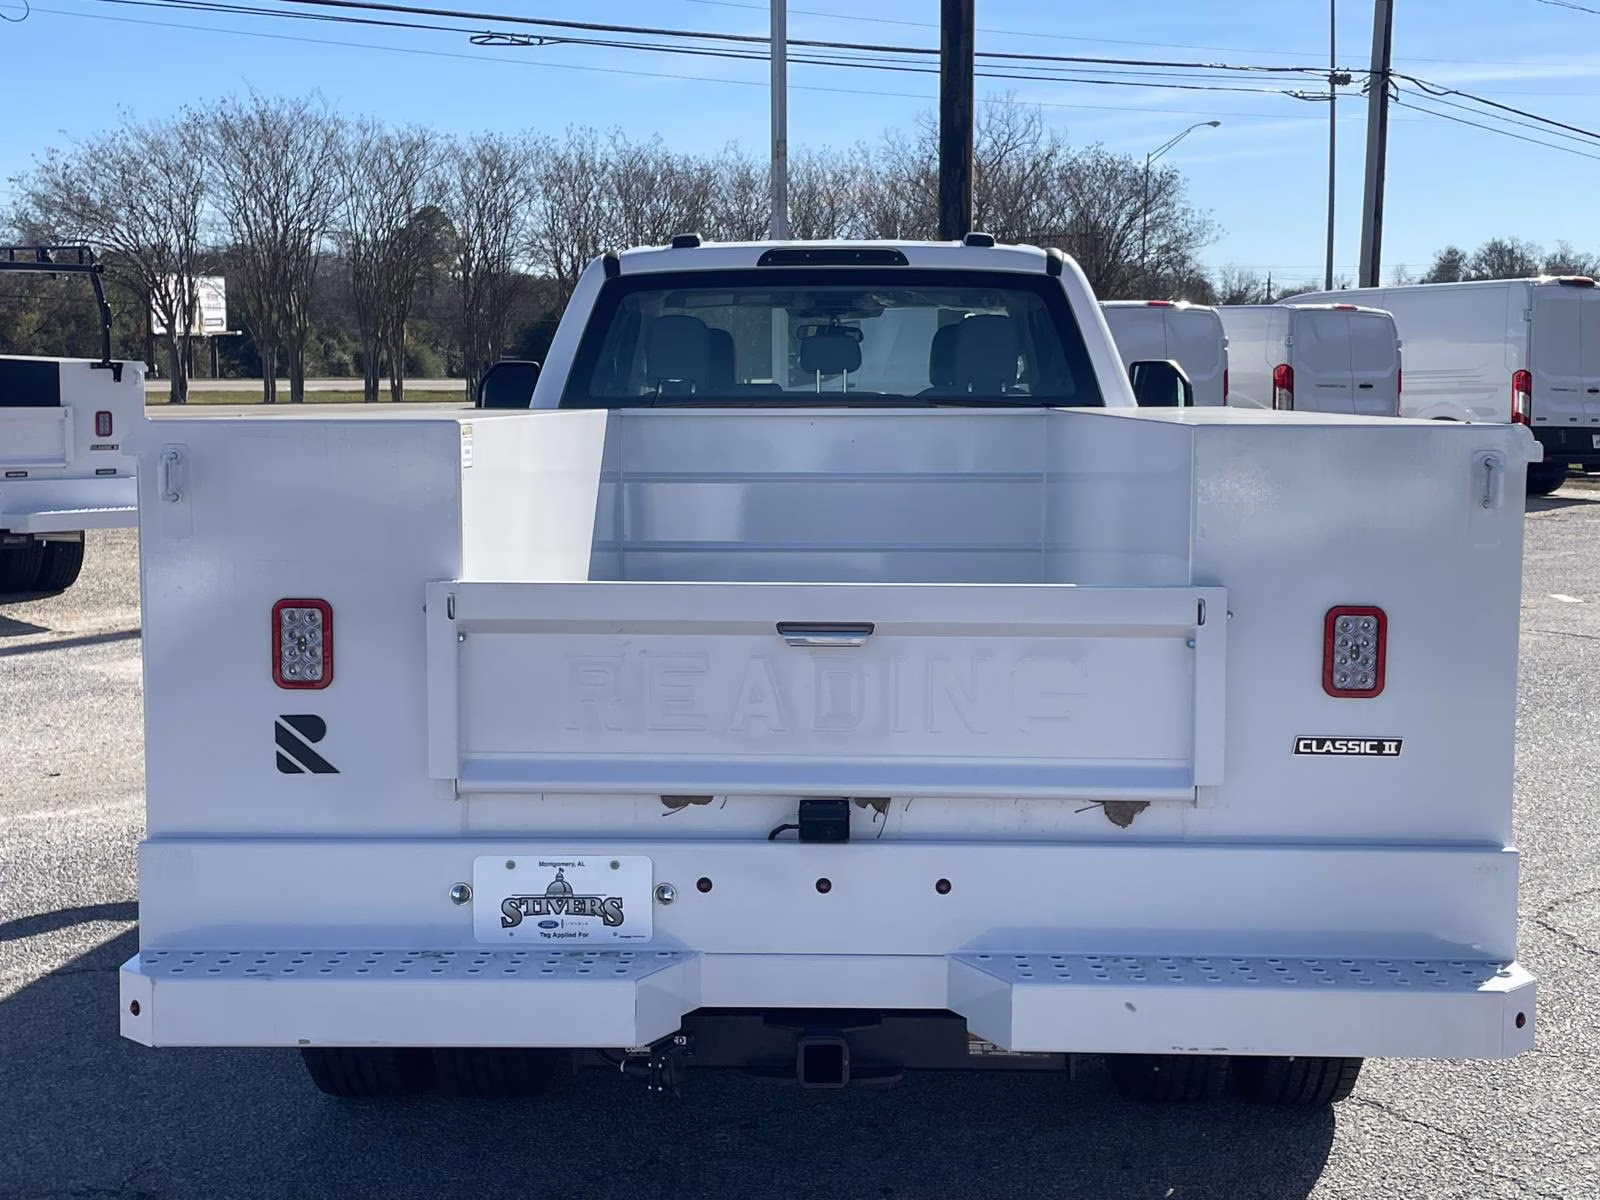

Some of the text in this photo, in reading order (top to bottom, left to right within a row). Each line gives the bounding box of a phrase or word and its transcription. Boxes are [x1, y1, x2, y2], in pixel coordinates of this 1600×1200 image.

[564, 650, 1090, 736] READING
[1298, 739, 1398, 754] CLASSIC II
[501, 897, 624, 928] STIVERS
[552, 931, 577, 939] Applied
